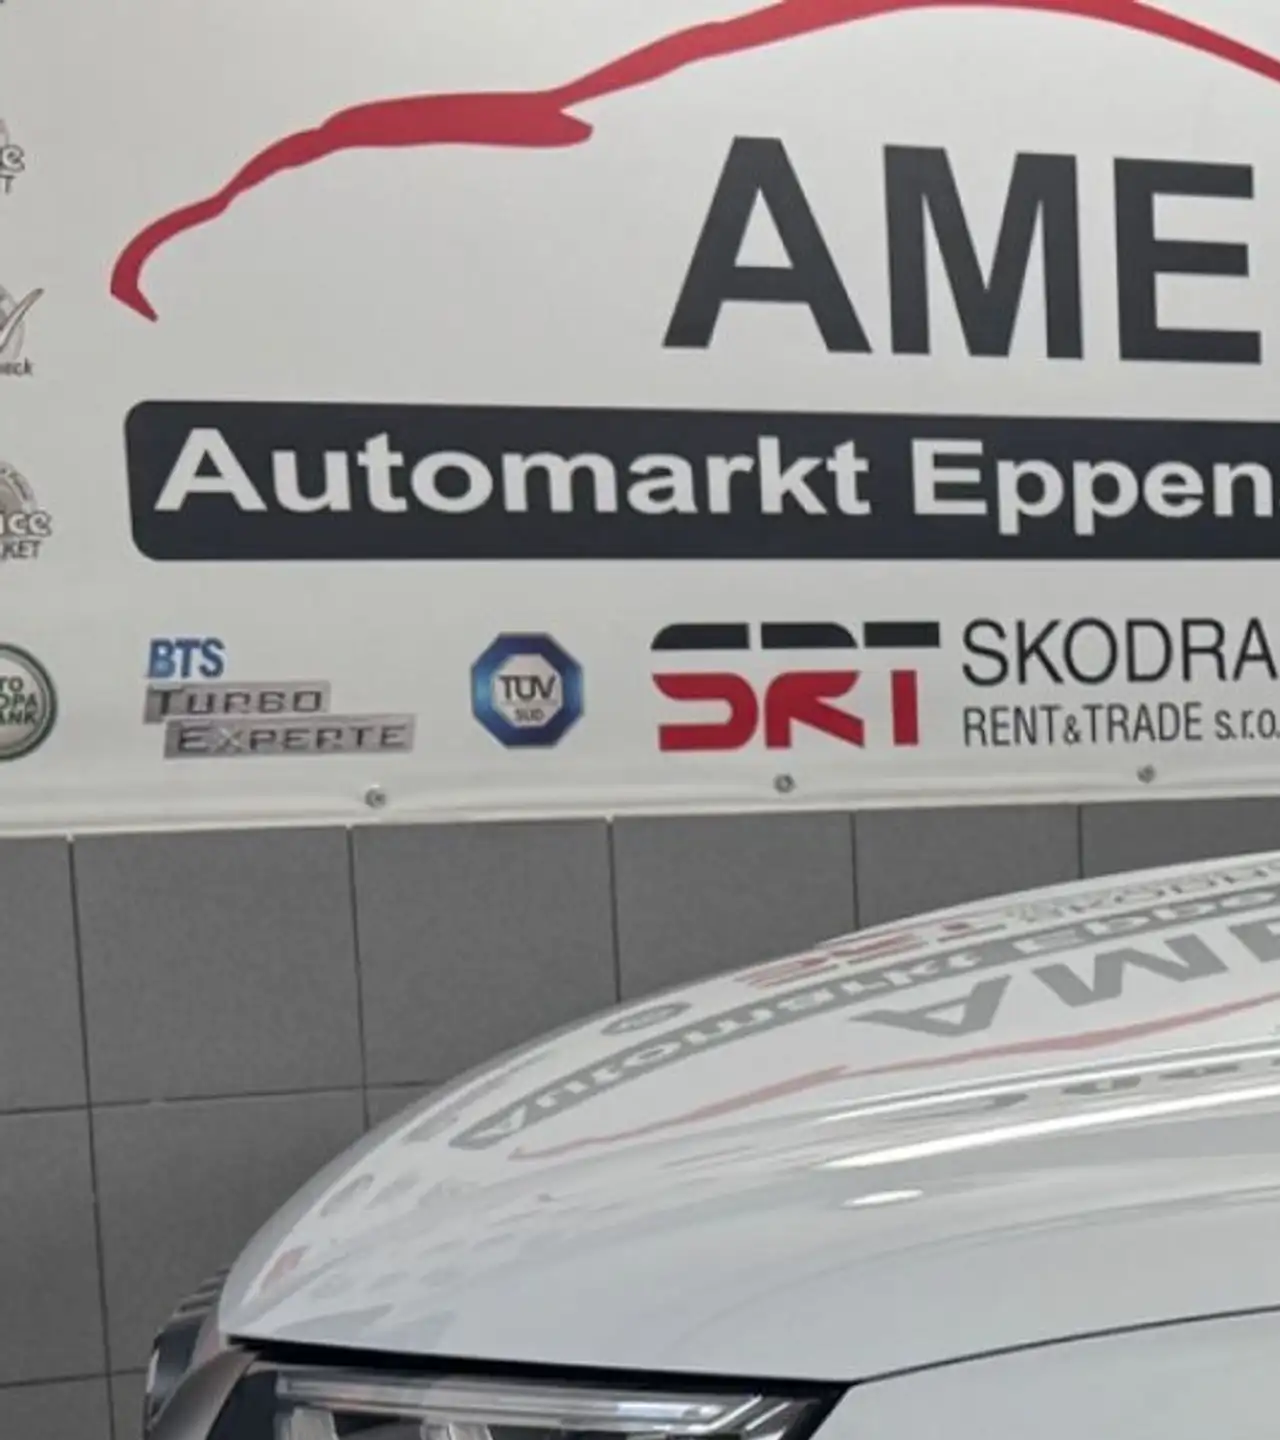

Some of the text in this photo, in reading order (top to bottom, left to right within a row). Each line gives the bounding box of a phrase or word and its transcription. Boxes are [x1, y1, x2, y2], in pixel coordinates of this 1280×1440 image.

[662, 136, 1262, 365] AME
[154, 426, 872, 516] Automarkt
[147, 638, 225, 679] BTS
[650, 621, 941, 752] SRT
[962, 617, 1278, 687] SKODRA
[963, 701, 1202, 747] RENT&TRADE
